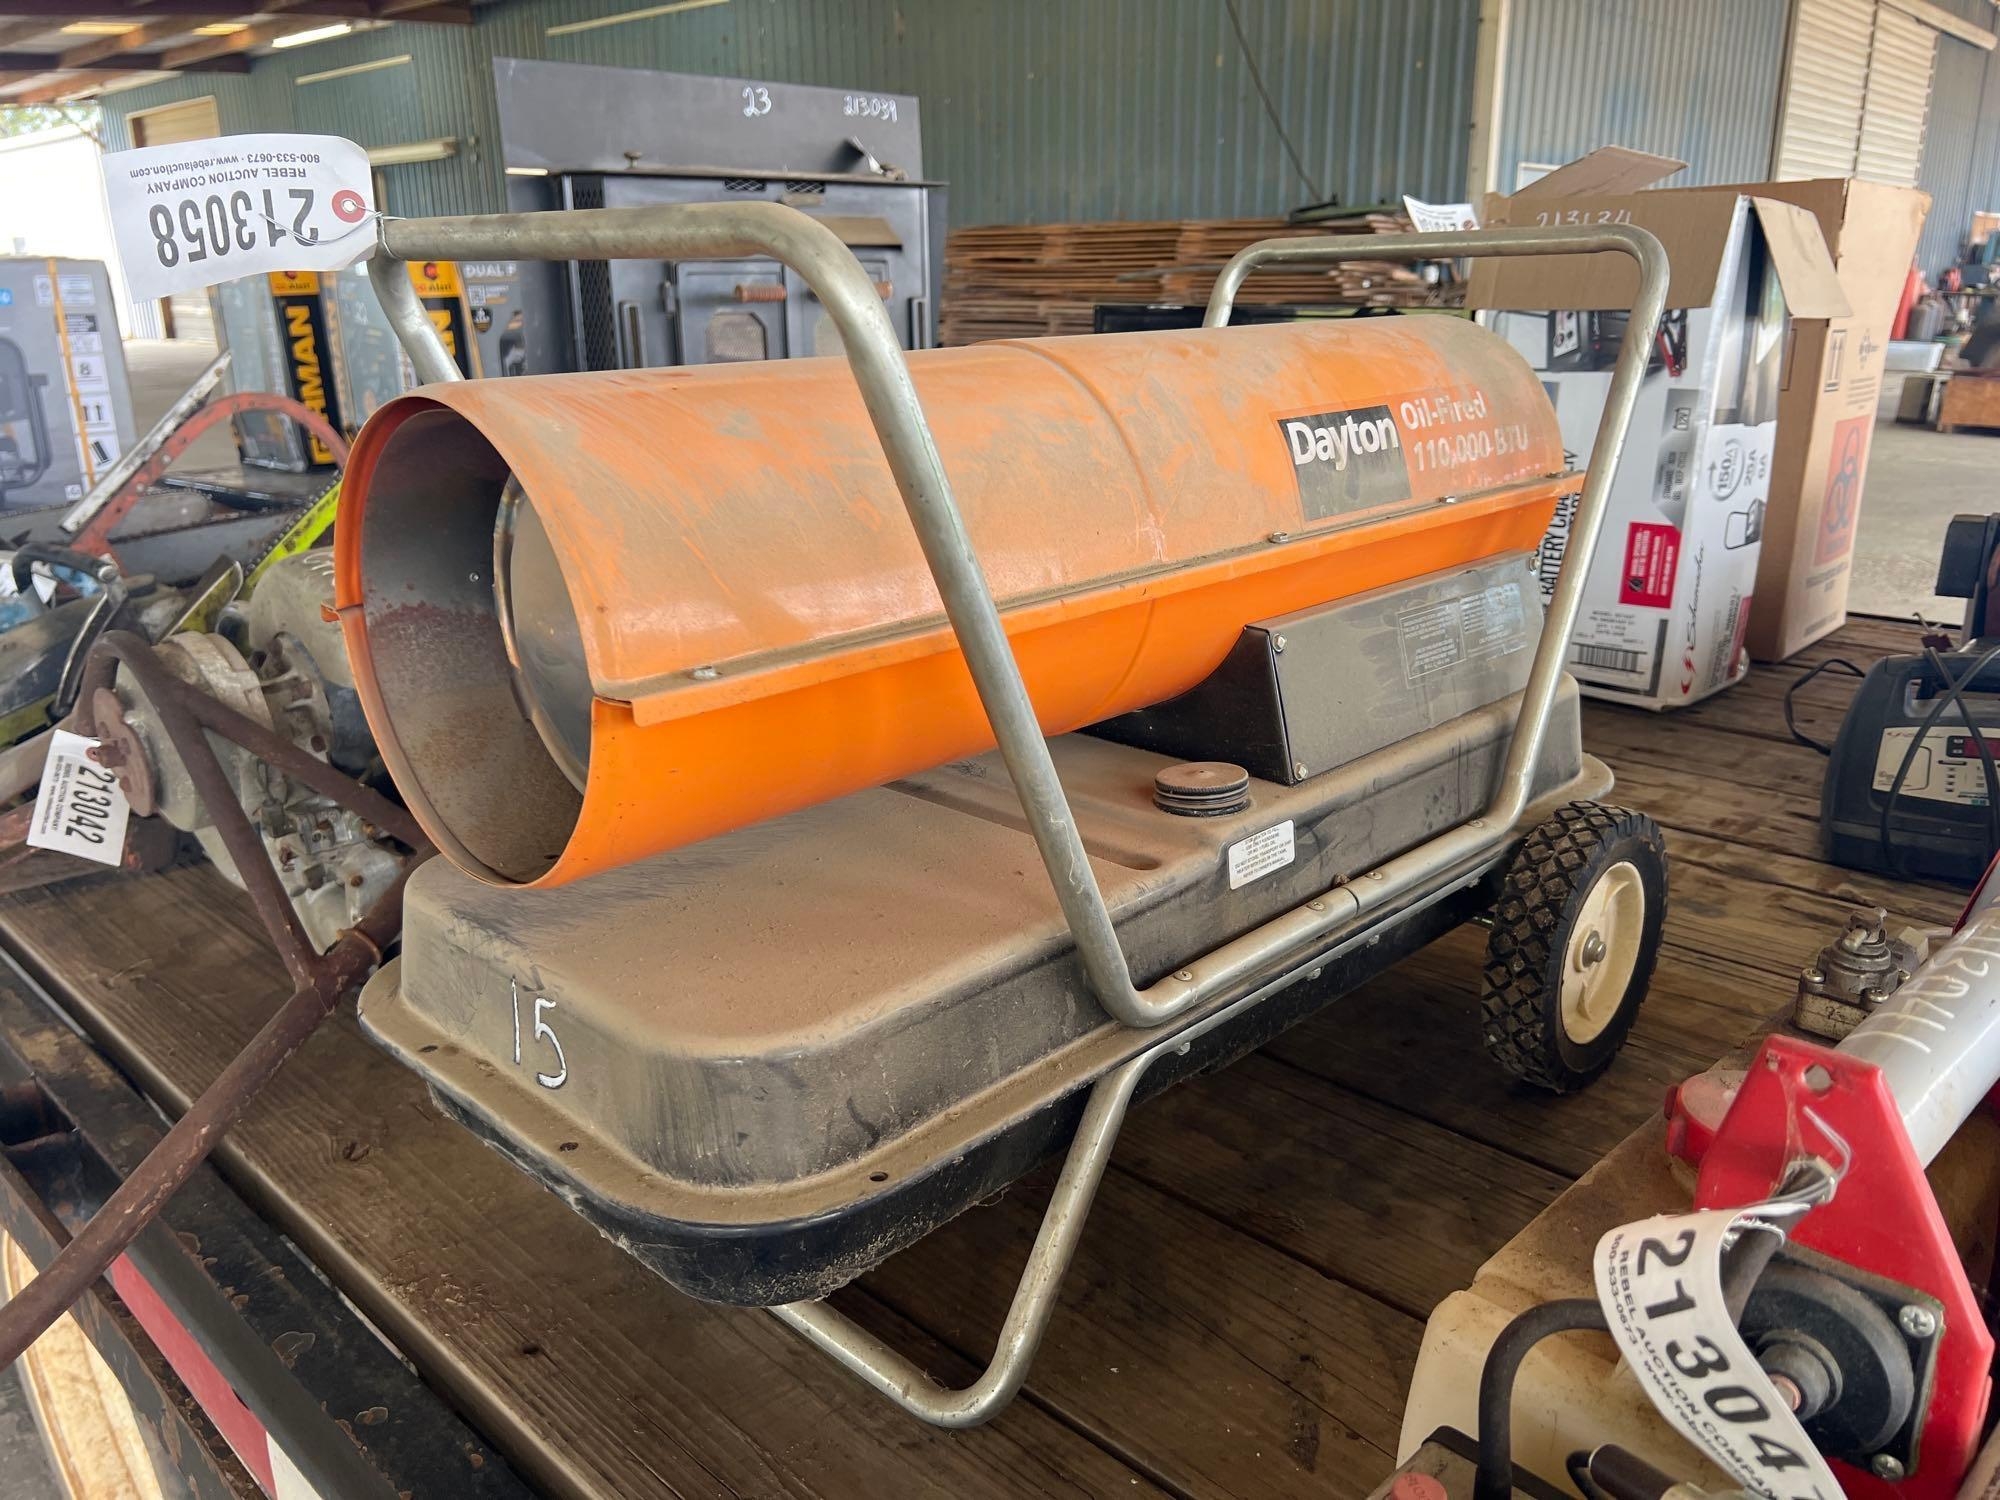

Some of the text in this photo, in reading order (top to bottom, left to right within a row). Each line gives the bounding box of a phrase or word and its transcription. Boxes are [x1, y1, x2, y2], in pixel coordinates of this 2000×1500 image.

[742, 86, 772, 118] 23
[129, 153, 320, 179] 800-533-0673 www.rebelauction.com
[147, 166, 307, 196] REBEL AUCTION COMPANY
[149, 188, 319, 268] 213058
[1399, 390, 1488, 430] Oil-Fired
[1286, 413, 1399, 472] Dayton
[1413, 424, 1529, 472] 110,000 BTU
[65, 765, 116, 844] 213042
[510, 977, 568, 1090] 15
[1608, 1233, 1638, 1345] 800-533-0673
[1619, 1249, 1637, 1321] REBEL
[1635, 1326, 1702, 1416] AUCTION
